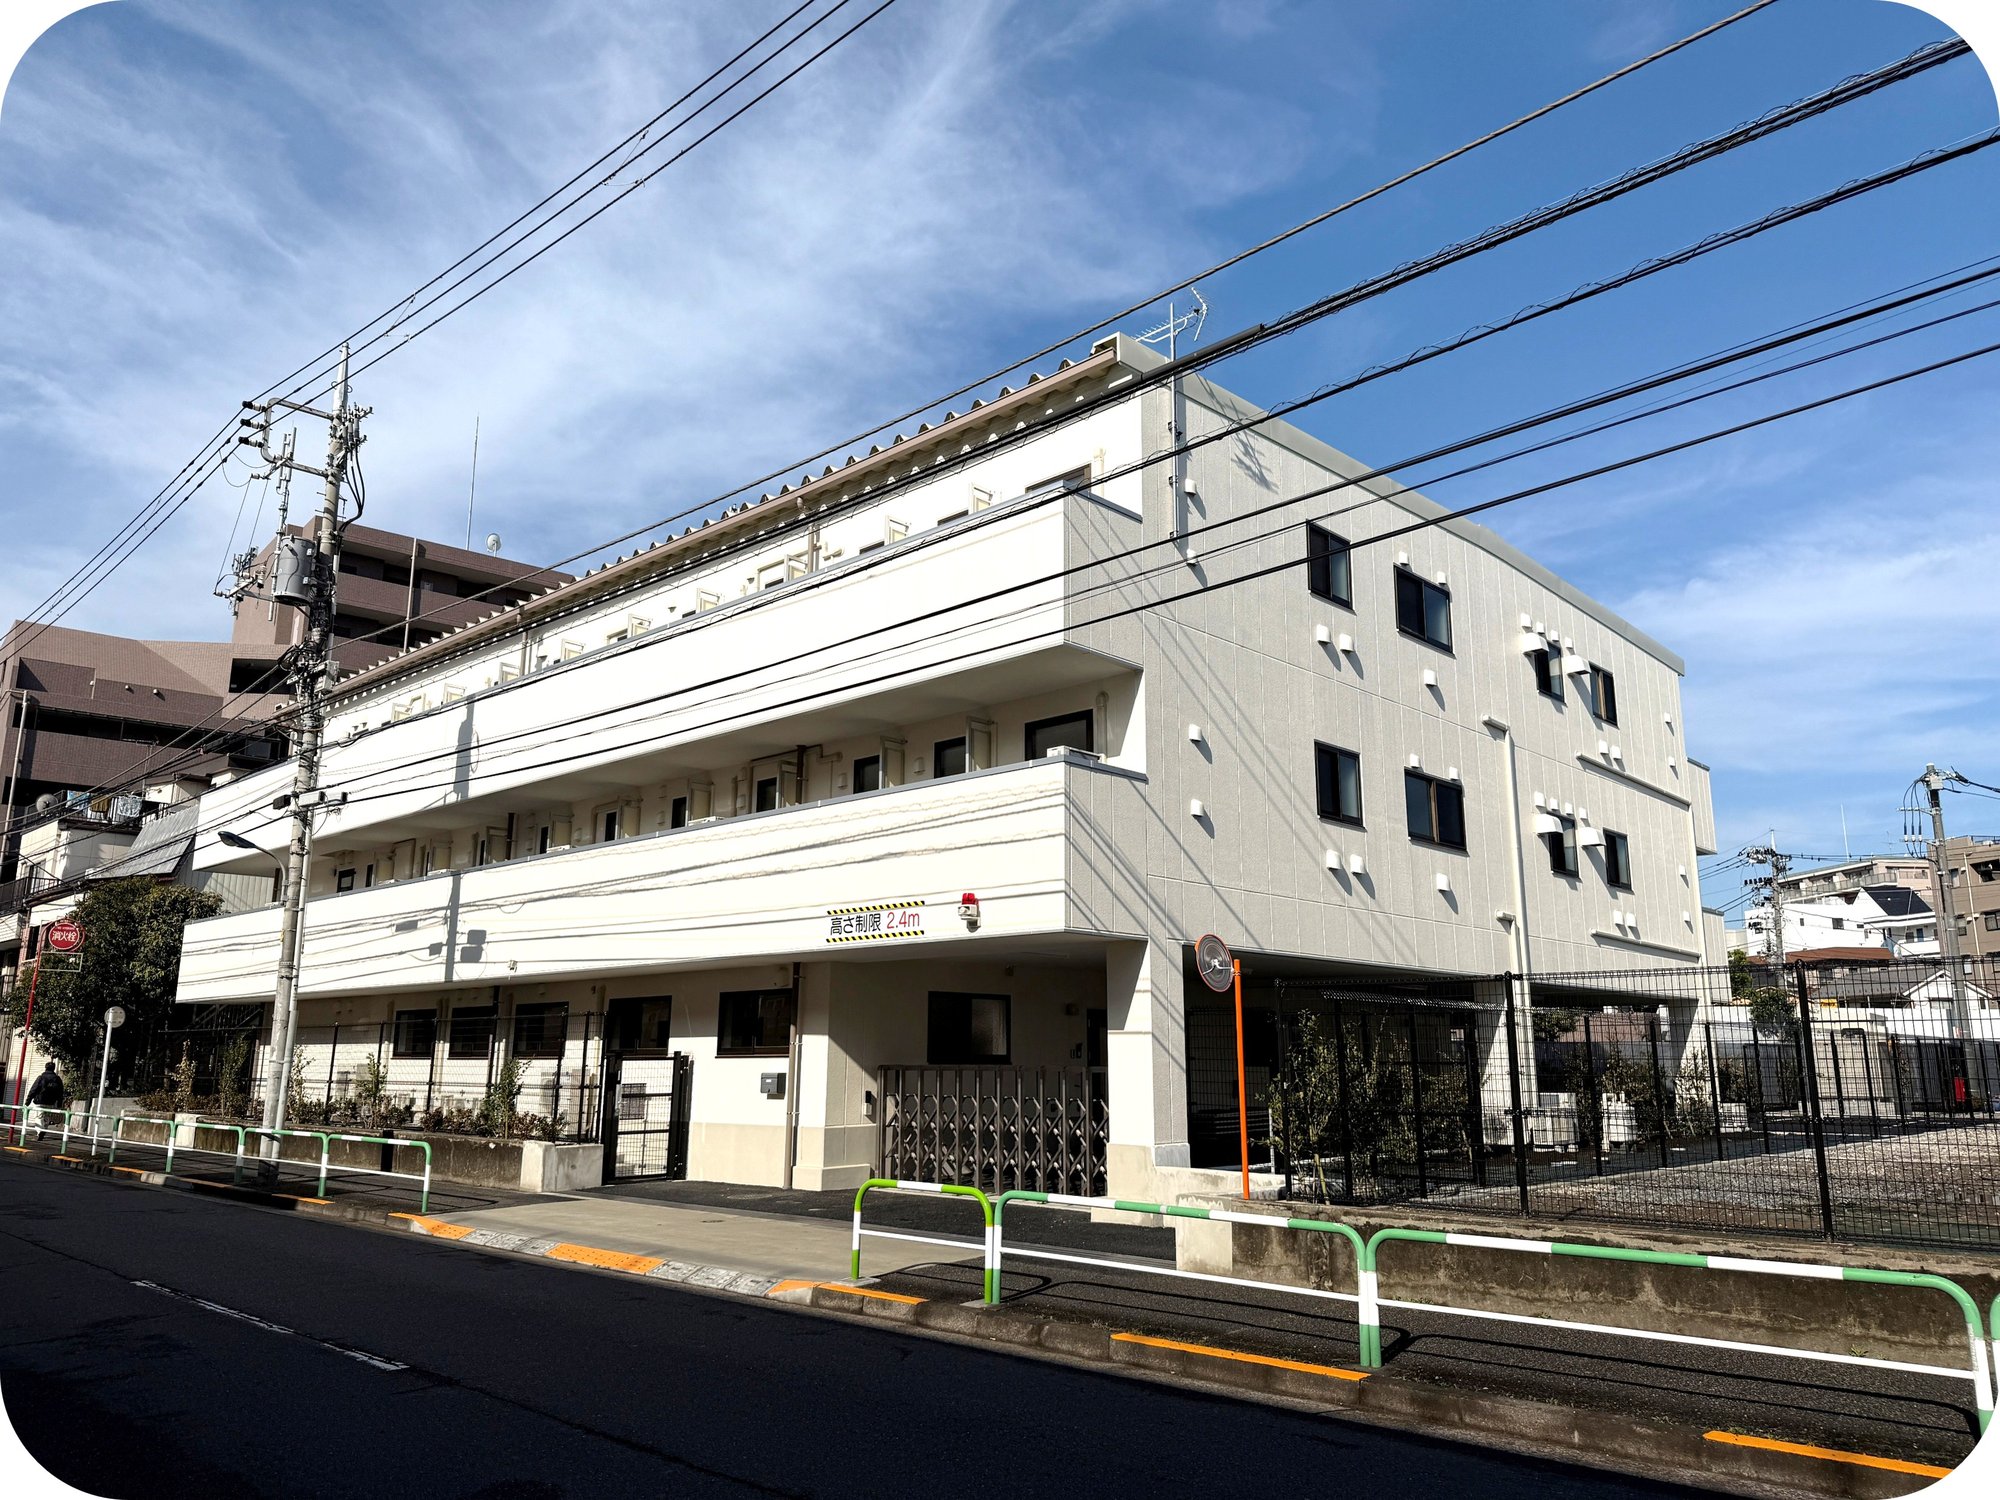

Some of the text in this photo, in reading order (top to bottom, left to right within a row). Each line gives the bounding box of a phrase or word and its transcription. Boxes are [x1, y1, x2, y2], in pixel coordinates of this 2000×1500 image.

[830, 911, 920, 935] 高さ制限 2.4m
[51, 930, 77, 942] 消火栓
